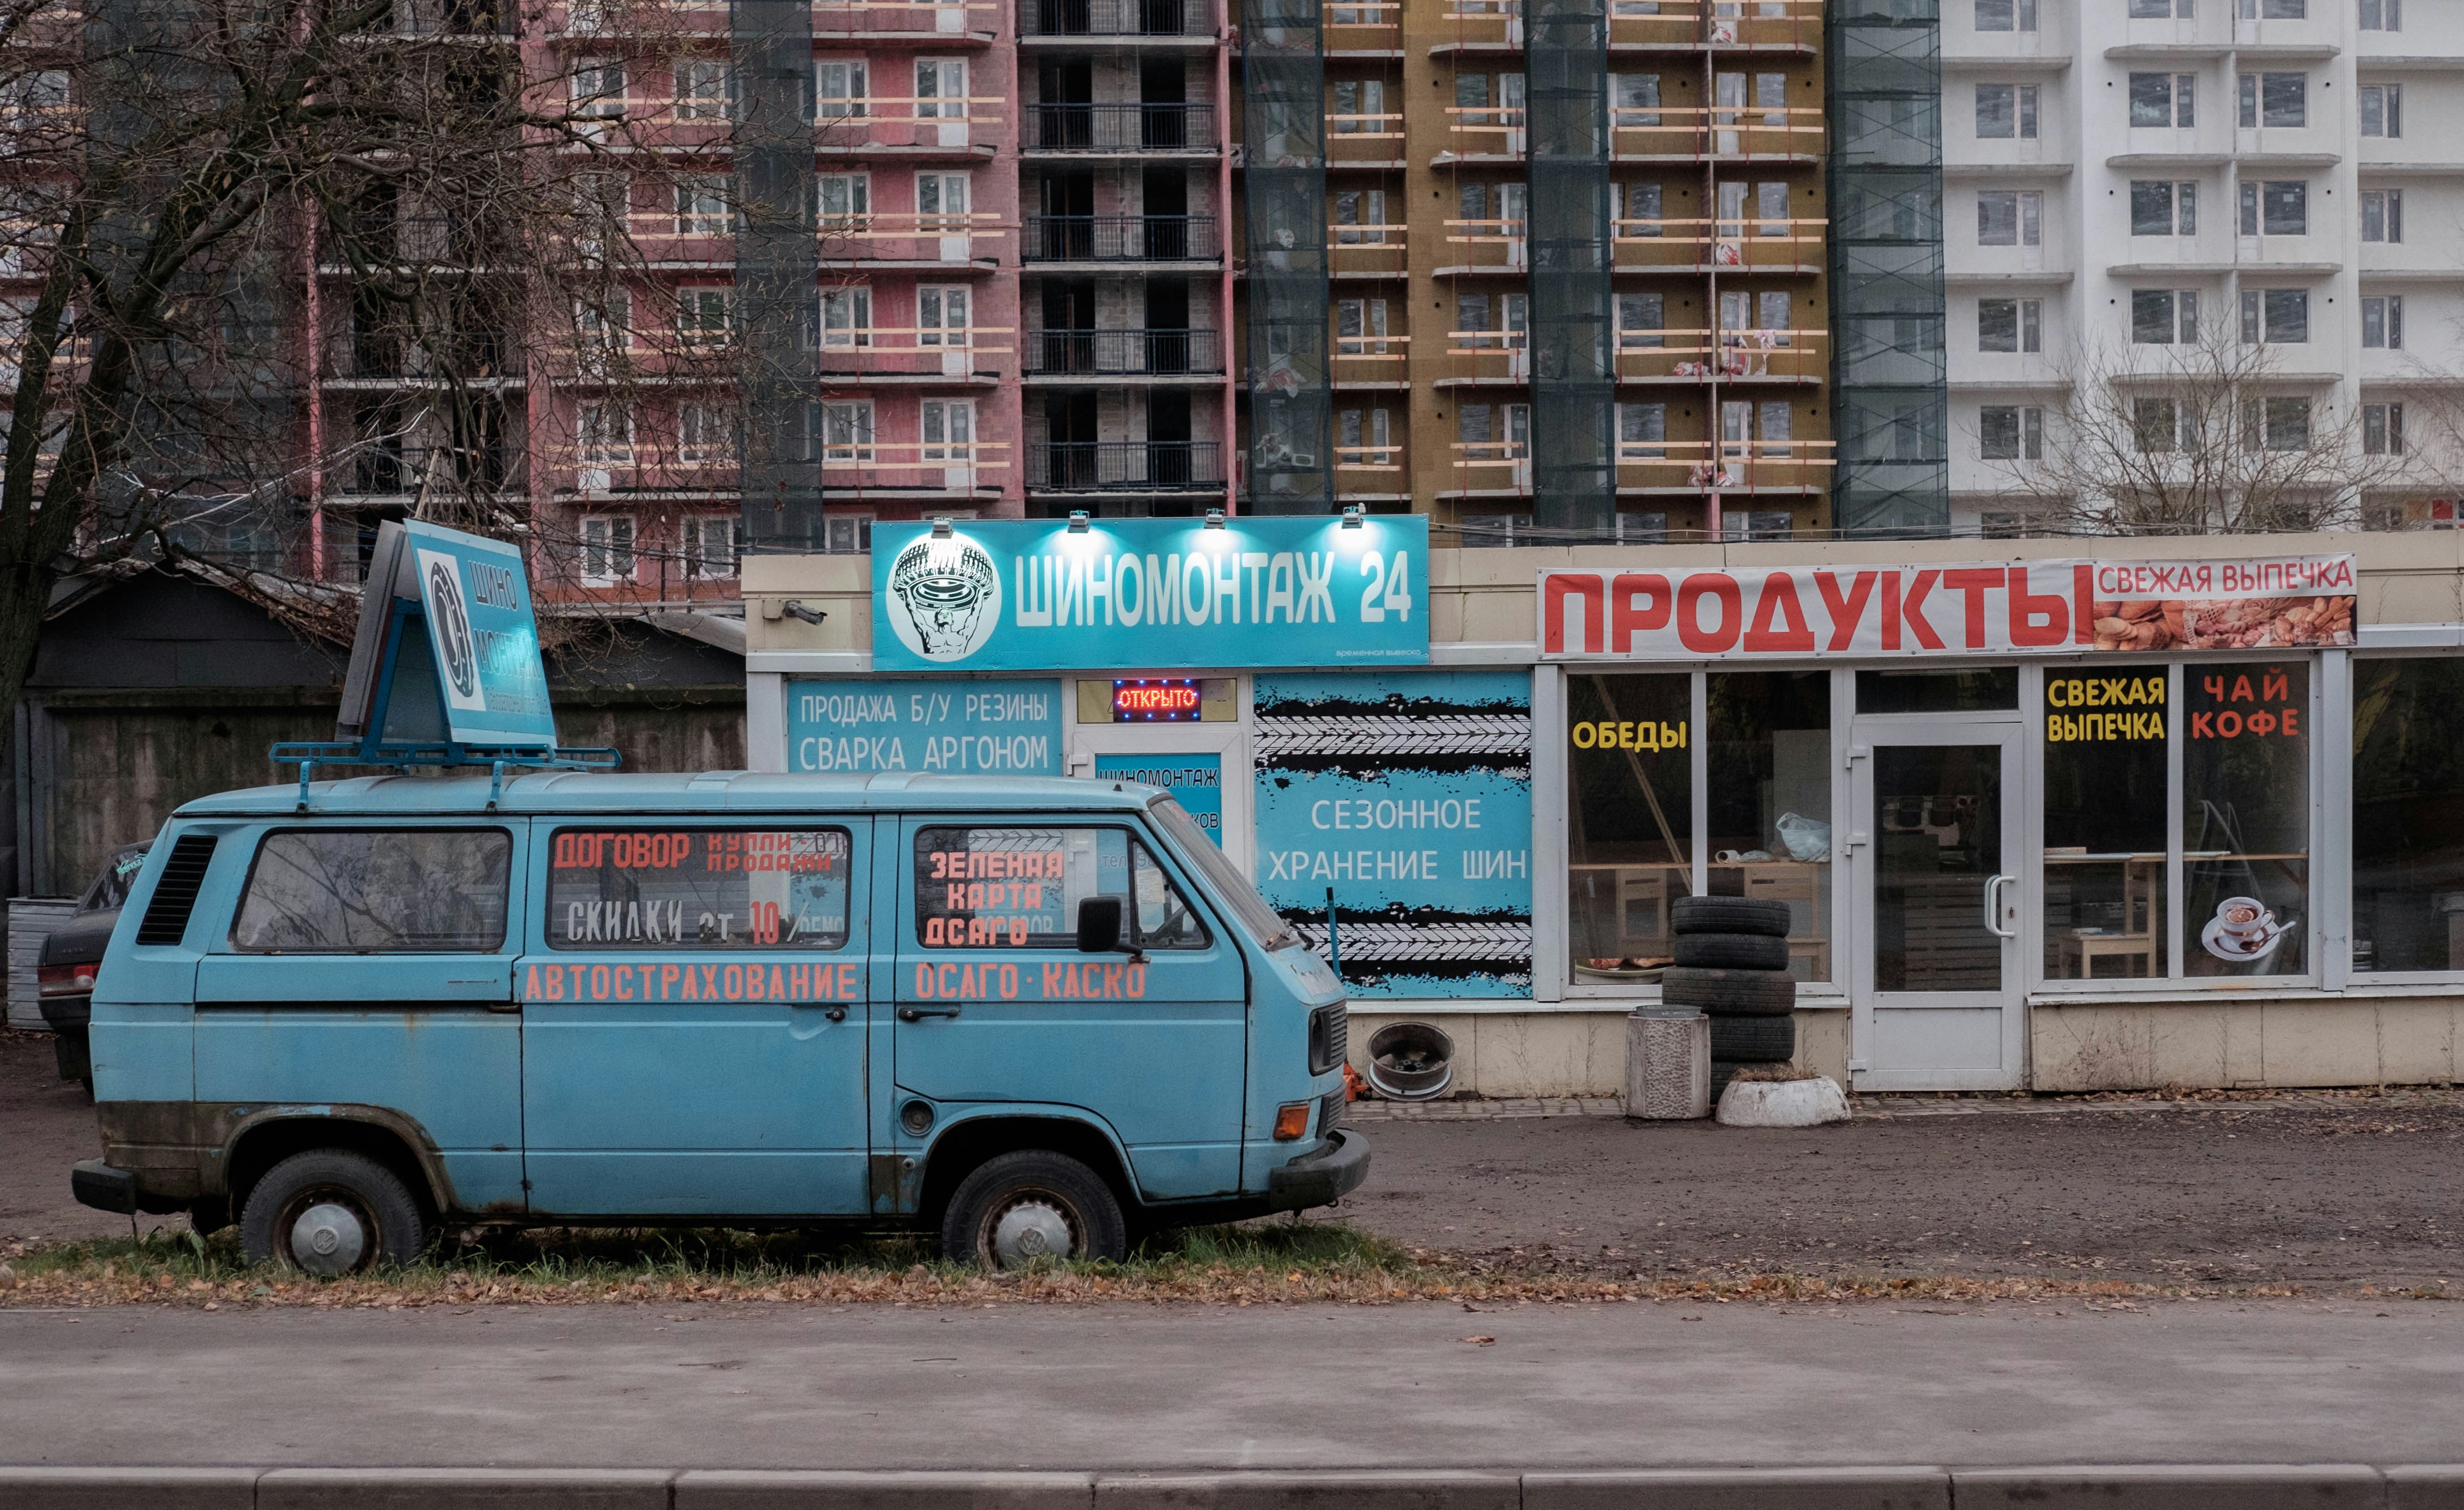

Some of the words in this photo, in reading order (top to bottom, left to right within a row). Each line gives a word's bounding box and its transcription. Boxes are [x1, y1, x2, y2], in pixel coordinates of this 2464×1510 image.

[468, 560, 518, 612] ШИНО
[1016, 551, 1336, 626] ШИНОМОНТАЖ
[1360, 550, 1411, 622] 24
[2098, 564, 2211, 594] СВЕЖАЯ
[2223, 559, 2353, 592] ВЫПЕЧКА
[1544, 565, 2093, 653] ПРОДУКТЫ
[1119, 689, 1196, 708] ОТКРЫТО
[2048, 677, 2165, 707] СВЕЖАЯ
[2203, 667, 2288, 702] ЧАЙ
[800, 694, 897, 727] ПРОДАЖА
[911, 692, 950, 726] Б/У
[966, 694, 1048, 722] РЕЗИНЫ
[2192, 708, 2299, 740] КОФЕ
[1572, 721, 1686, 753] ОБЕДЫ
[2048, 712, 2165, 741] ВЫПЕЧКА
[800, 736, 905, 771] СВАРКА
[923, 736, 1049, 770] АРГОНОМ
[1311, 799, 1481, 830] СЕЗОННОЕ
[553, 833, 690, 869] ДОГОВОР
[708, 833, 791, 852] КУПЛИ
[708, 854, 831, 872] ПРОДАЖИ
[930, 852, 1064, 879] ЗЕЛЕНАЯ
[1268, 850, 1438, 880] ХРАНЕНИЕ
[1463, 850, 1526, 879] ШИН
[947, 883, 1041, 910] КАРТА
[750, 901, 780, 945] 10
[925, 918, 1027, 945] ДСАГО
[525, 964, 857, 1001] АВТОСТРАХОВАНИЕ
[915, 962, 1018, 999] ОСАГО
[1043, 962, 1145, 999] КАСКО
